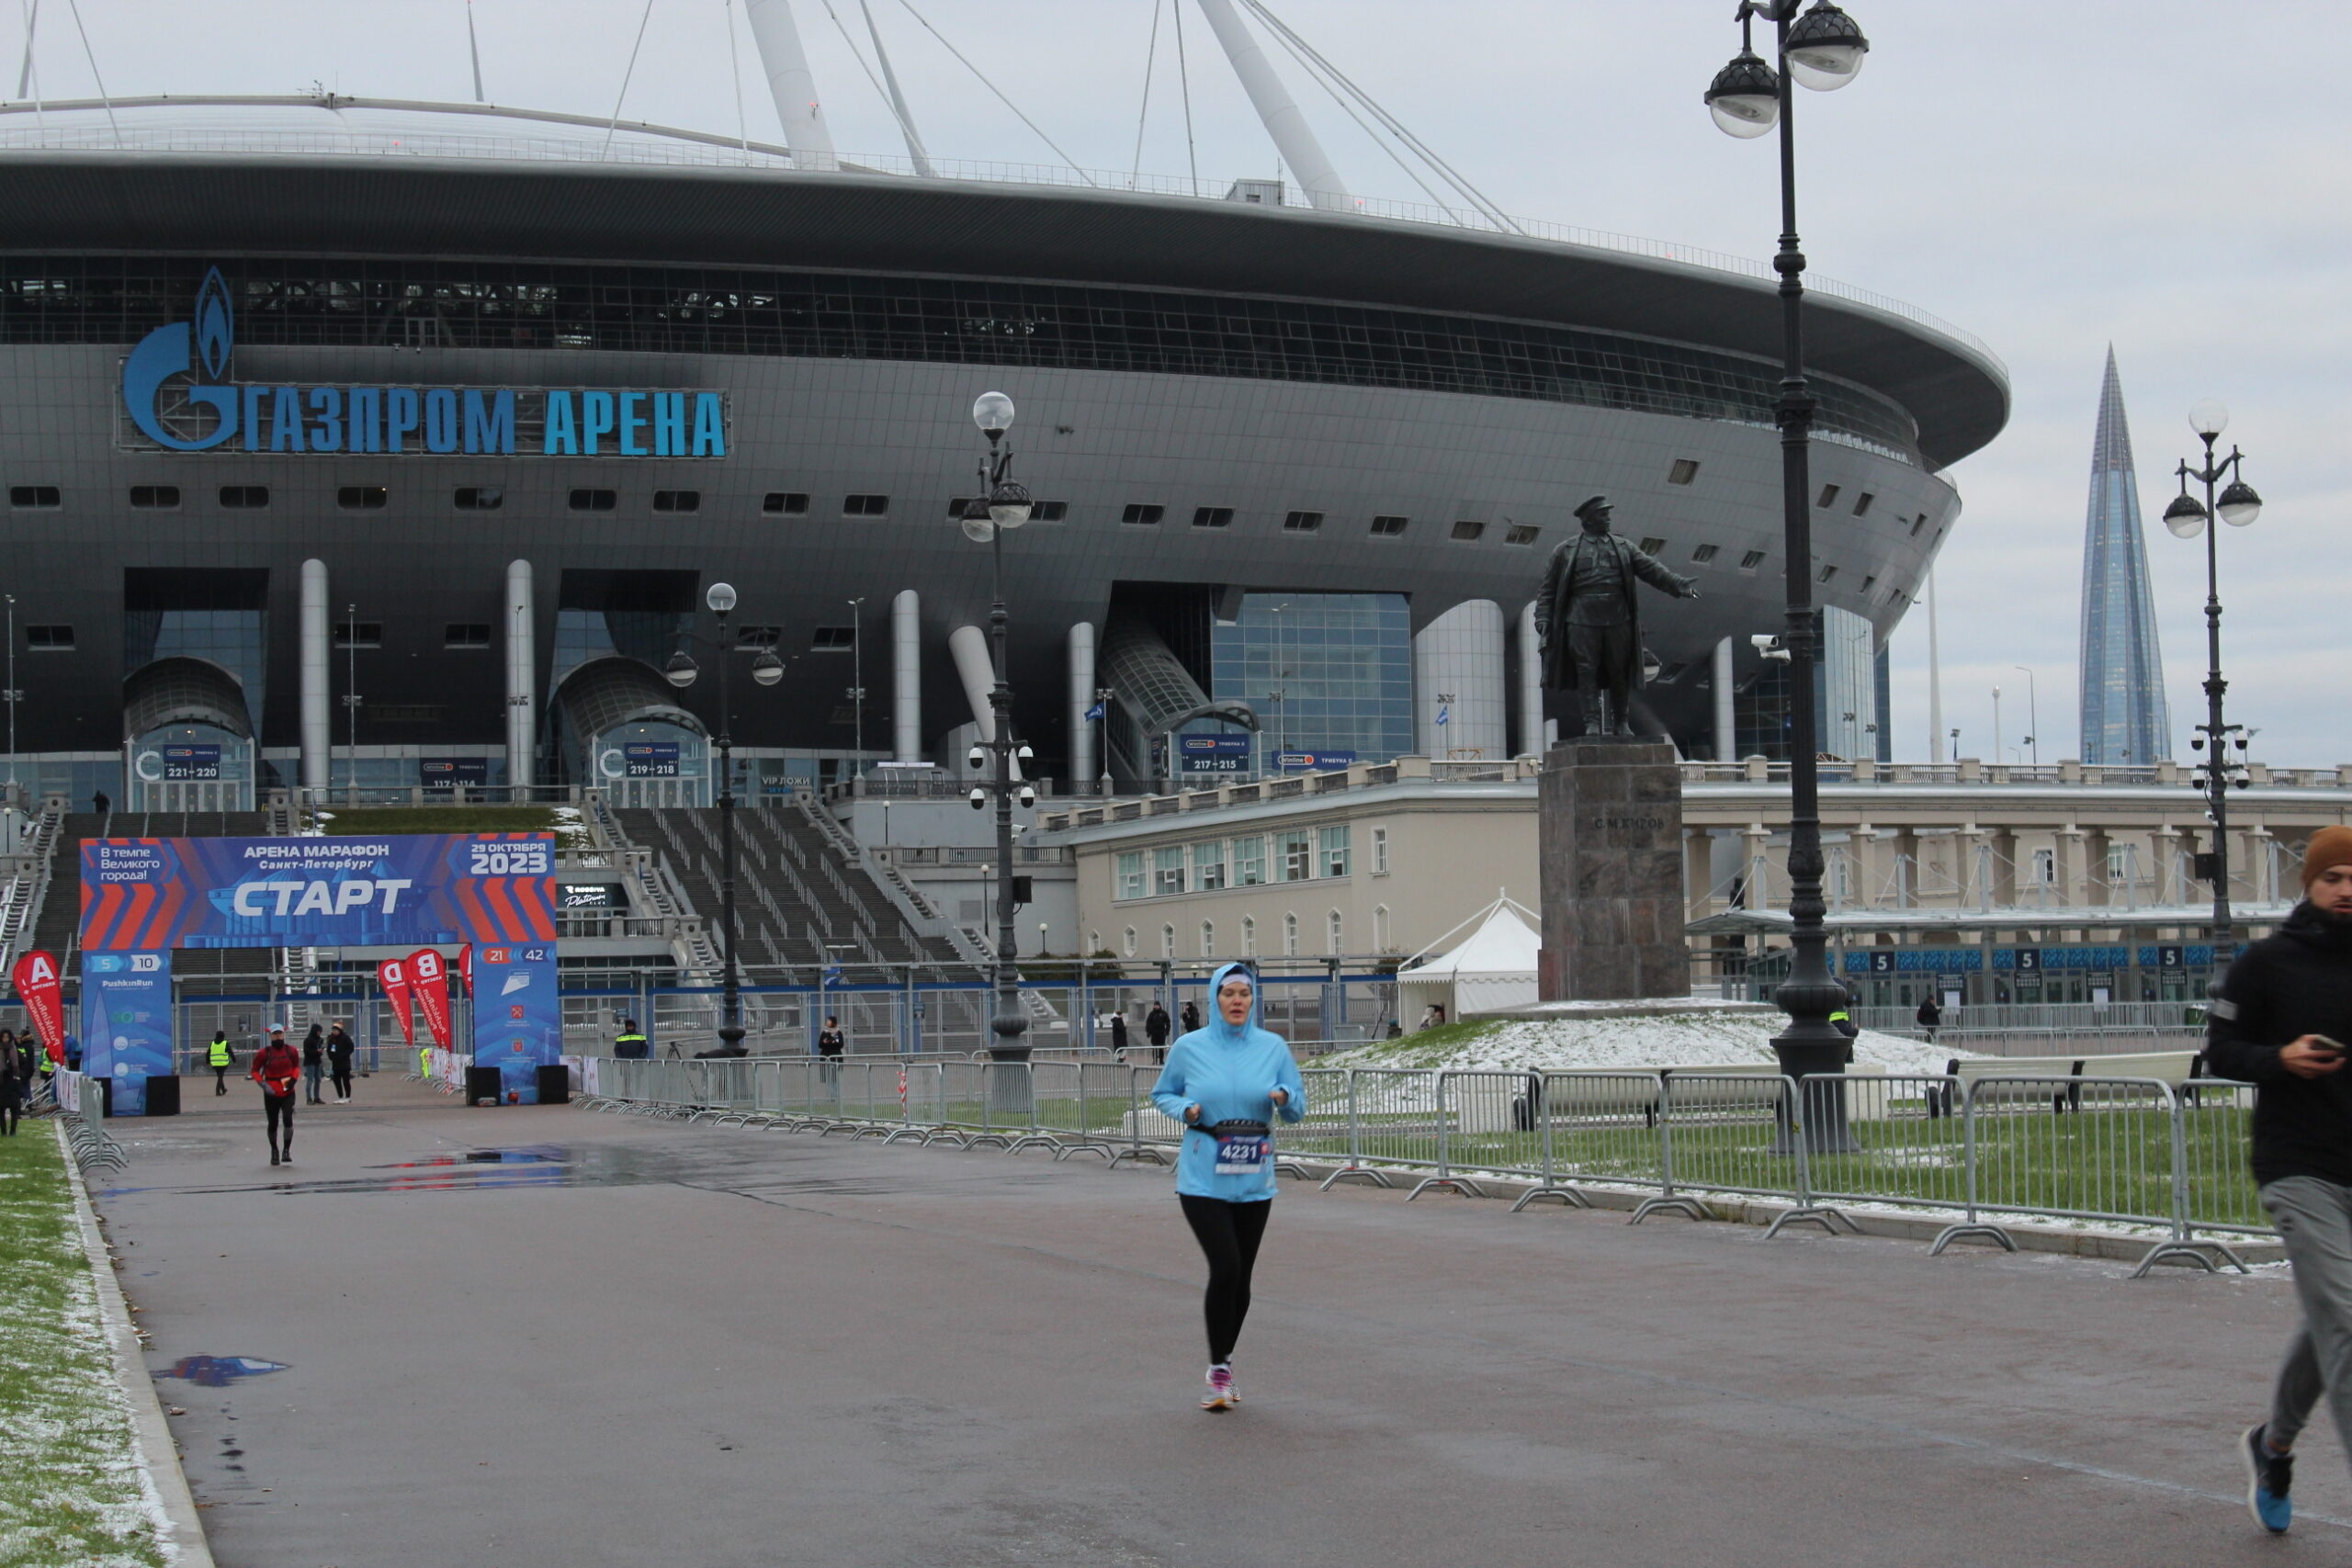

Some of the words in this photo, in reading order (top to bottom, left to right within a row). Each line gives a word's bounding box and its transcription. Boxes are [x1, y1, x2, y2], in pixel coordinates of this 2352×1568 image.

[243, 386, 514, 454] ГАЗПРОМ
[544, 389, 726, 457] АРЕНА
[779, 777, 809, 785] ЛОЖИ
[100, 848, 110, 858] В
[112, 849, 151, 858] темпе
[244, 846, 300, 858] АРЕНА
[303, 844, 390, 857] МАРАФОН
[471, 844, 486, 852] 29
[488, 843, 547, 852] ОКТЯБРЯ
[100, 859, 161, 869] Великого
[259, 859, 374, 871] Санкт-Петербург
[470, 852, 548, 874] 2023
[100, 870, 147, 882] города!
[233, 879, 412, 917] СТАРТ
[490, 950, 503, 962] 21
[525, 950, 544, 961] 42
[2022, 953, 2032, 968] 5
[2165, 950, 2176, 965] 5
[101, 958, 111, 970] 5
[139, 957, 153, 968] 10
[1877, 955, 1887, 971] 5
